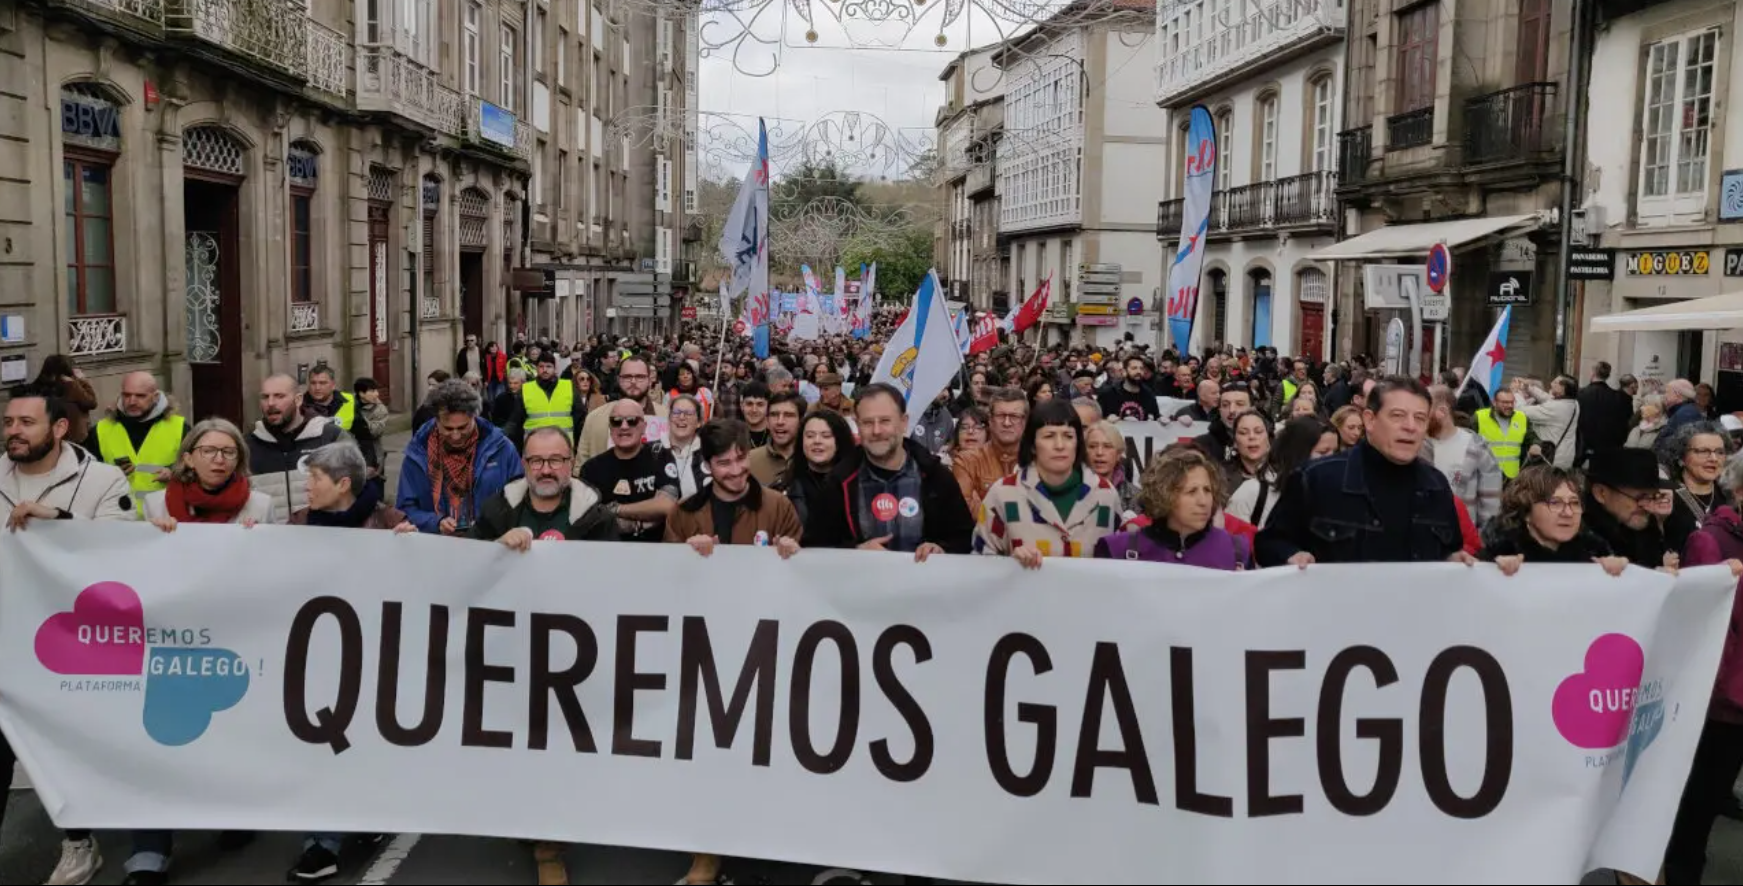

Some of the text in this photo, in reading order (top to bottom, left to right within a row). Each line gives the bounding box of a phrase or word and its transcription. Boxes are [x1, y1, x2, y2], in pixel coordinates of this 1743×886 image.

[63, 102, 120, 137] BBVA
[1570, 266, 1609, 275] PASTELERIA
[1628, 252, 1708, 274] MIGUEZ
[77, 624, 211, 646] QUEREMOS
[60, 680, 141, 692] PLATAFORMA
[283, 595, 1514, 820] QUEREMOS GALEGO
